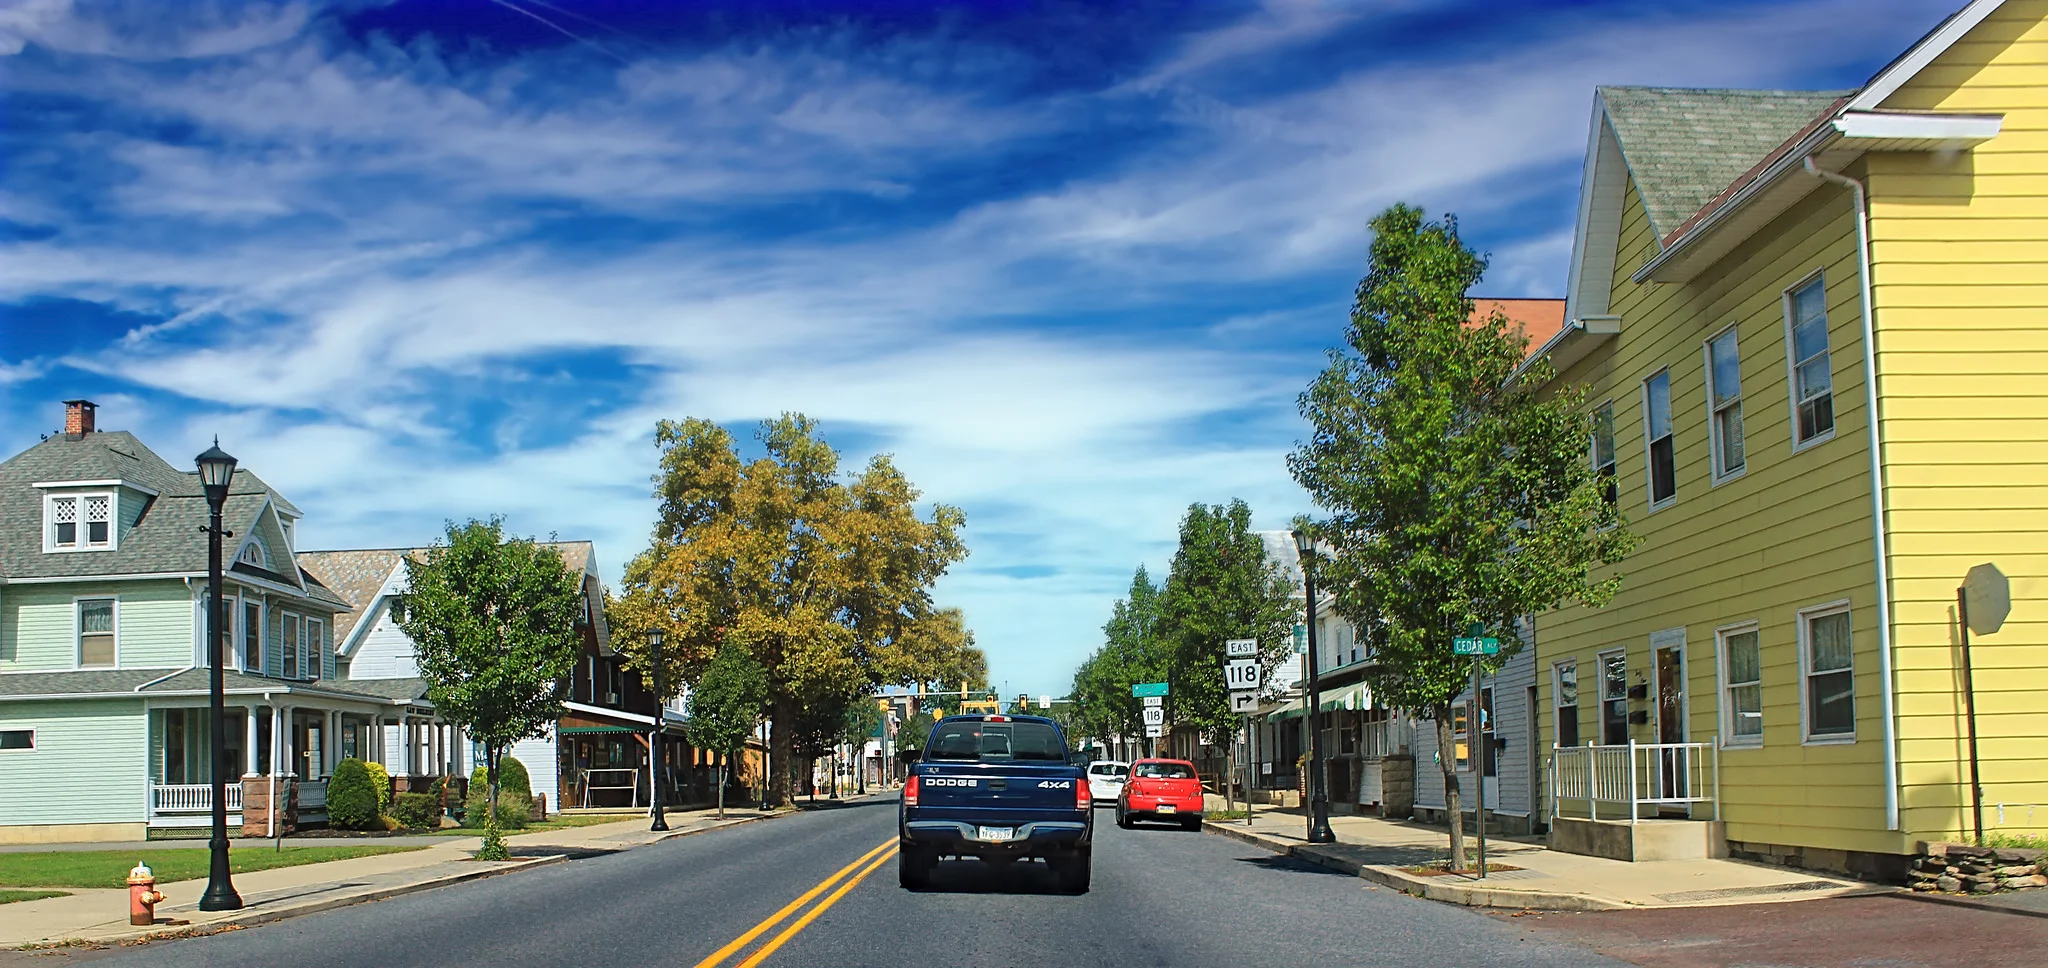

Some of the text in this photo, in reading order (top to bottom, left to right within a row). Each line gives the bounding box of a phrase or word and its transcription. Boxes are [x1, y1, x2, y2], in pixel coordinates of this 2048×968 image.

[1231, 643, 1253, 653] EAST
[1456, 640, 1483, 651] CEDAR
[1230, 666, 1256, 683] 118
[1146, 711, 1160, 721] 118
[925, 778, 978, 787] DODGE
